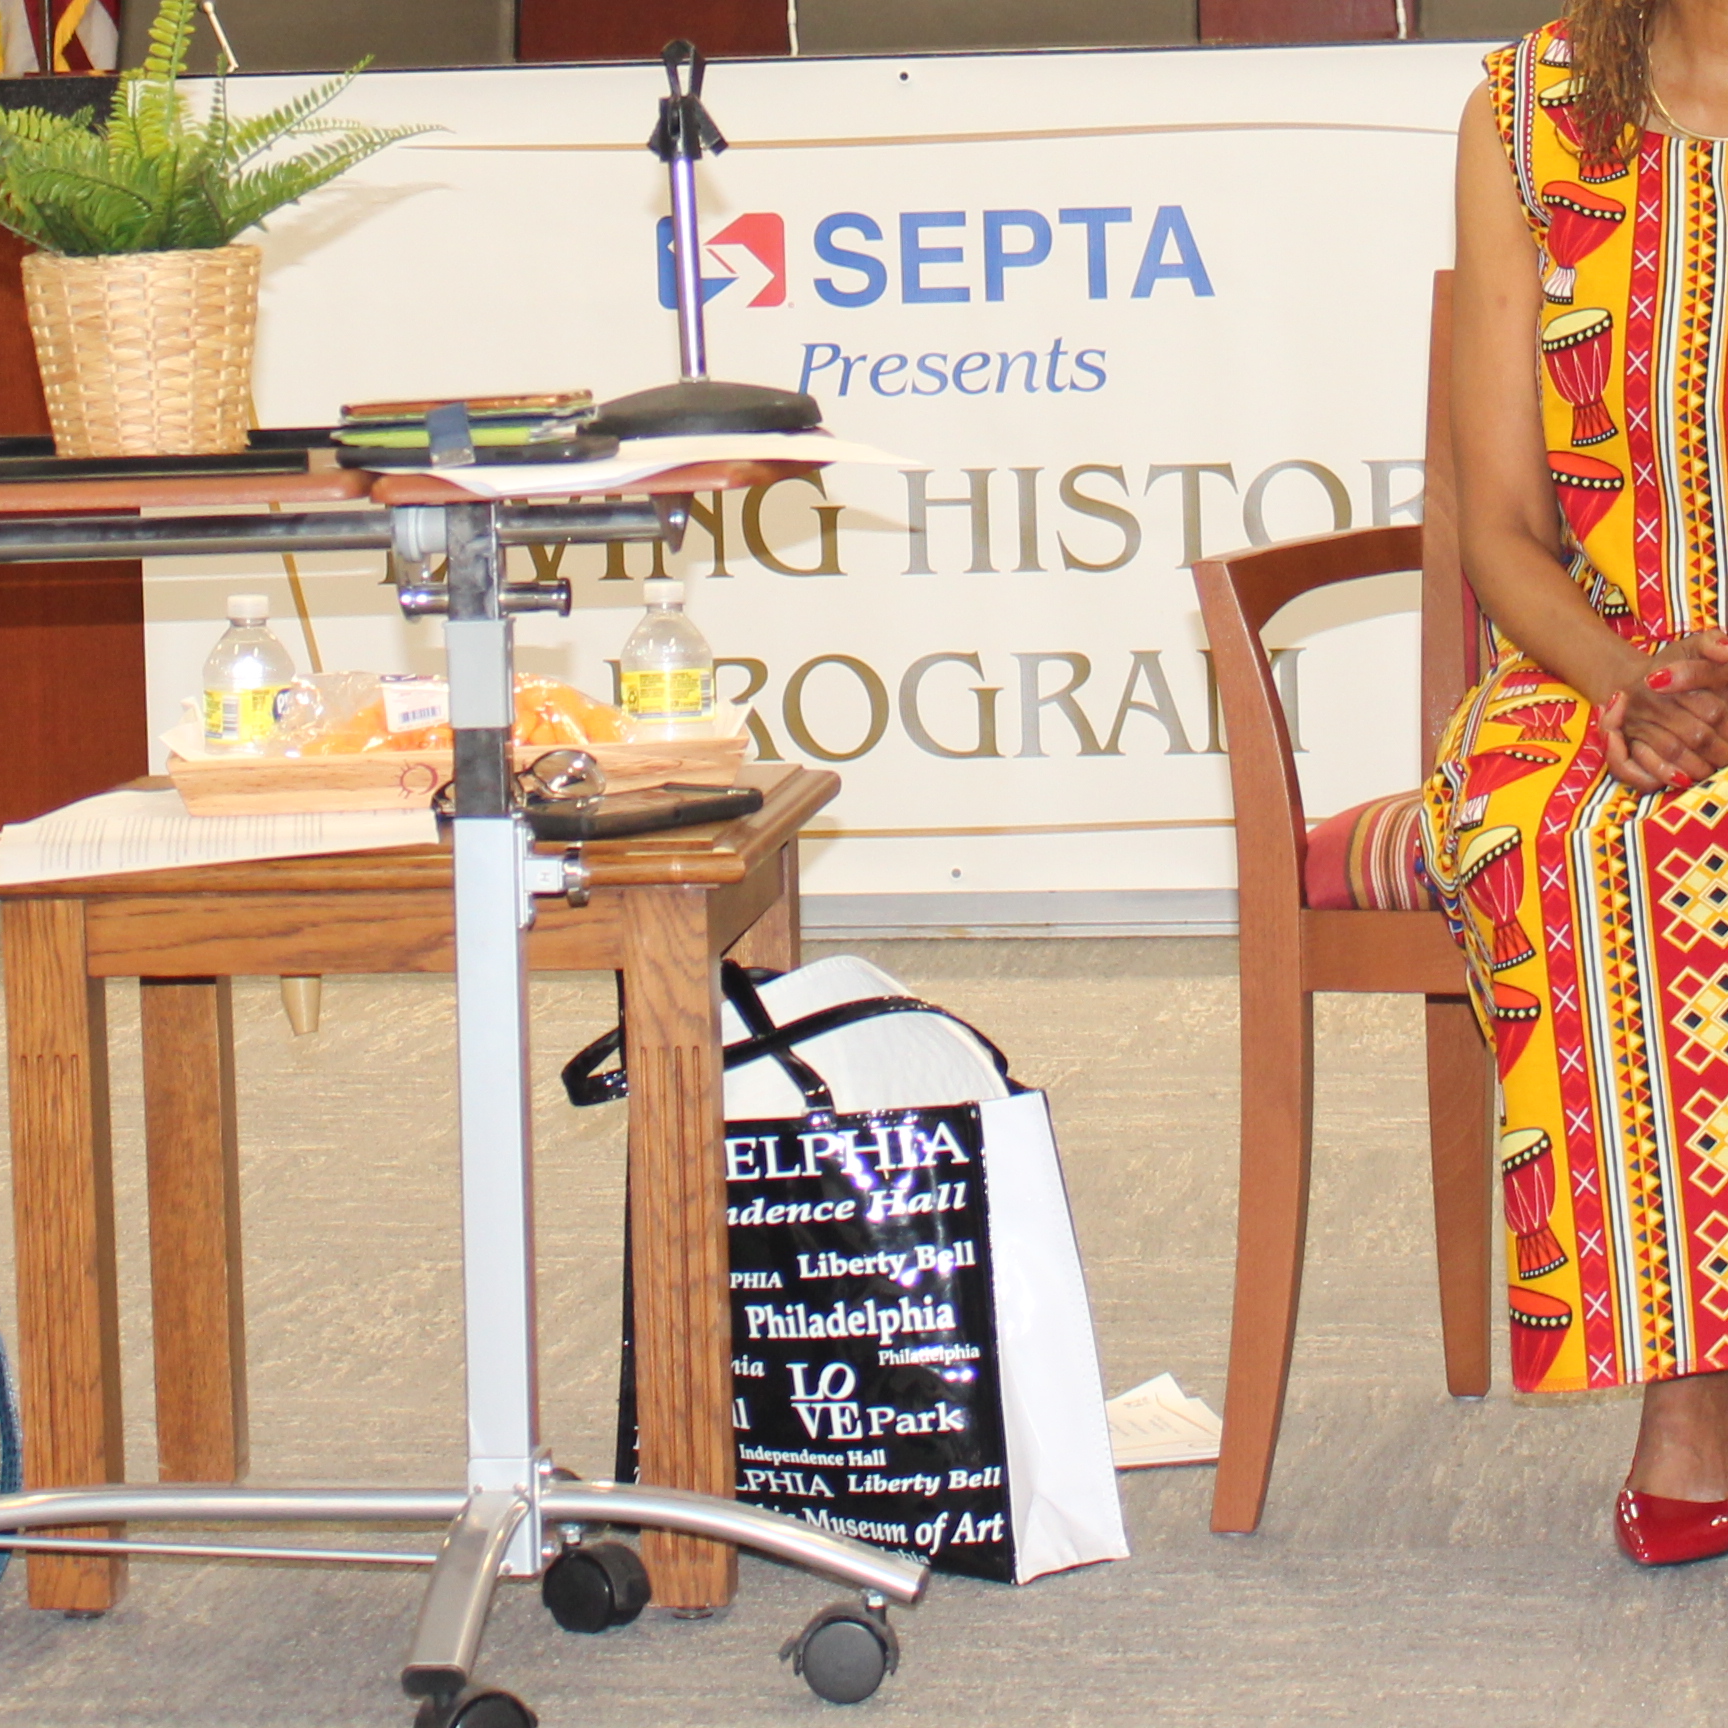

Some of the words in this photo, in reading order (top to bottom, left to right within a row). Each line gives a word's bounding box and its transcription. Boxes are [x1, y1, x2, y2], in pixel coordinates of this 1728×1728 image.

[813, 204, 1216, 309] SEPTA
[797, 335, 1108, 397] Presents
[724, 1121, 970, 1182] ELPHIA
[726, 1197, 856, 1227] ndence
[866, 1181, 967, 1220] Hall
[729, 1271, 783, 1290] PHIA
[796, 1251, 908, 1281] Liberty
[913, 1240, 977, 1272] Bell
[744, 1294, 957, 1346] Philadelphia
[877, 1343, 981, 1367] Philadelphia
[785, 1361, 857, 1401] LO
[790, 1401, 864, 1440] VE
[866, 1401, 966, 1437] Park
[738, 1443, 845, 1467] Independence
[847, 1448, 887, 1467] Hall
[847, 1471, 942, 1497] Liberty
[947, 1466, 1002, 1491] Bell
[914, 1511, 950, 1556] of
[950, 1511, 1004, 1545] Art
